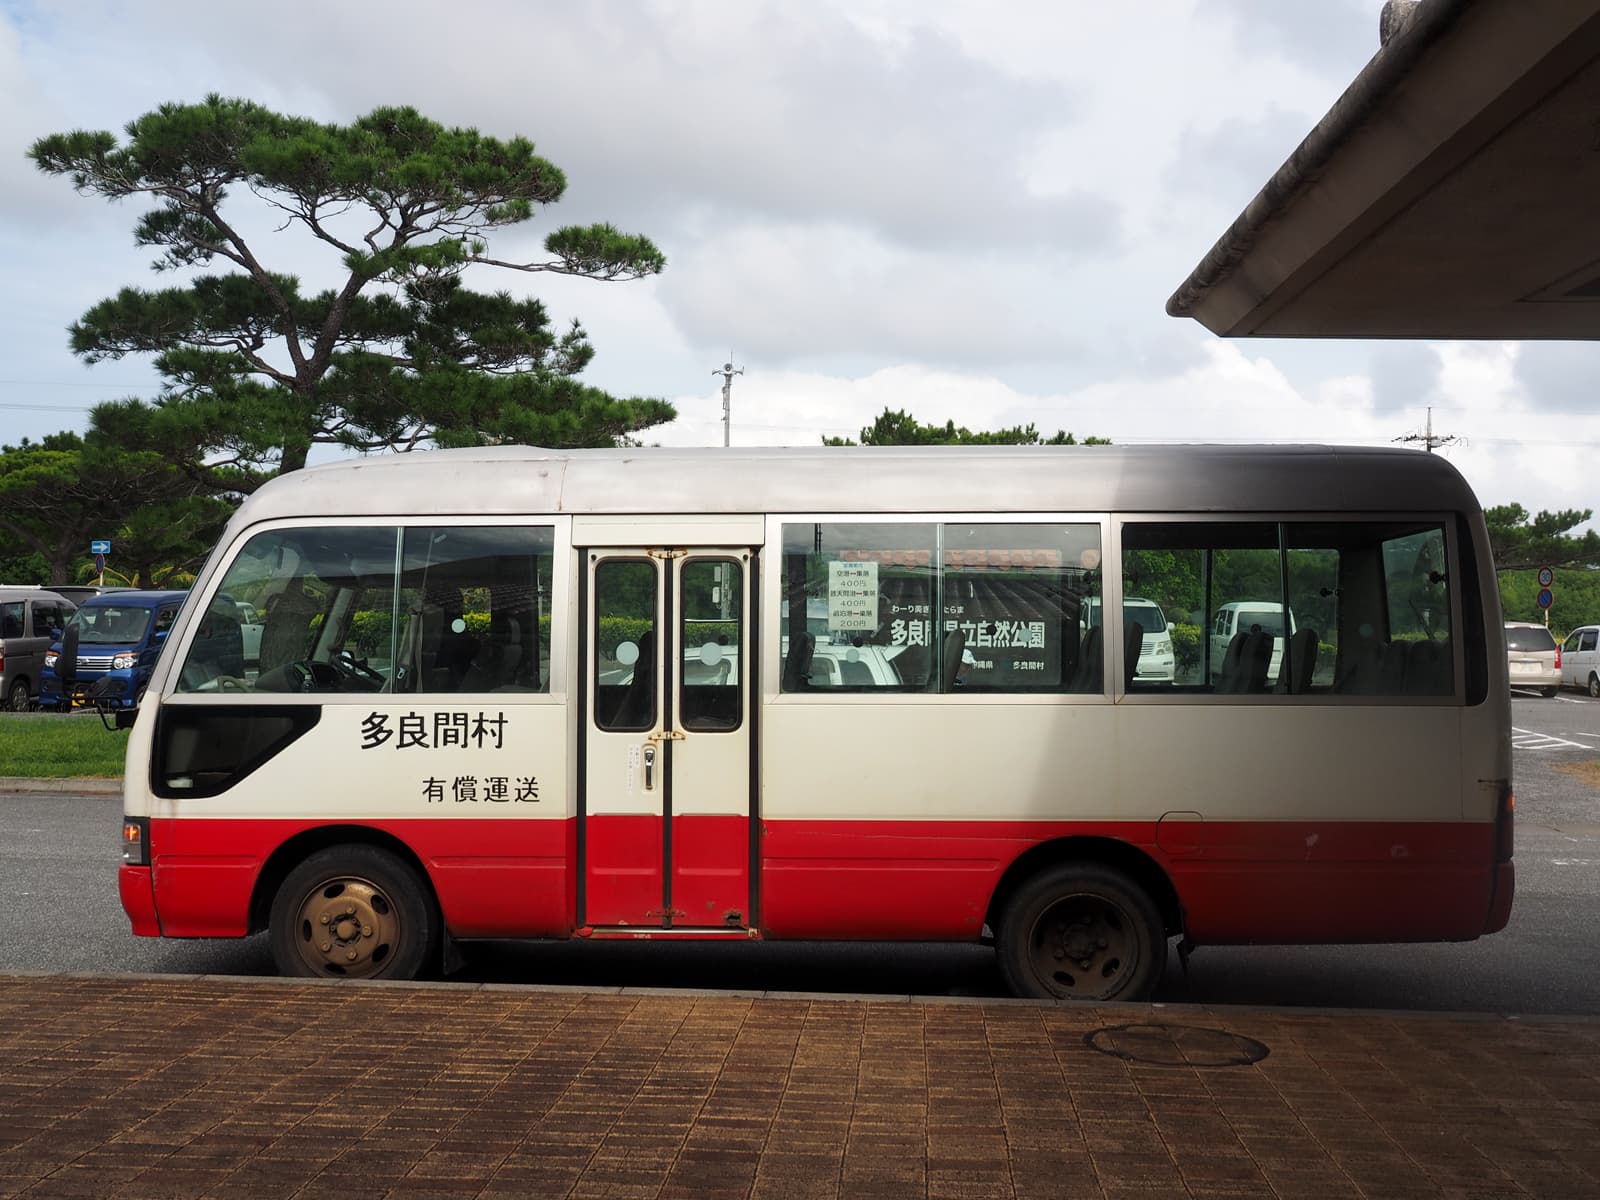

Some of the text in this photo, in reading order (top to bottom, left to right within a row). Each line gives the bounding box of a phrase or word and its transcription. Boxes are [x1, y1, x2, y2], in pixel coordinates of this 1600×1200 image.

[361, 711, 508, 750] 多良間村
[422, 776, 540, 803] 有償運送
